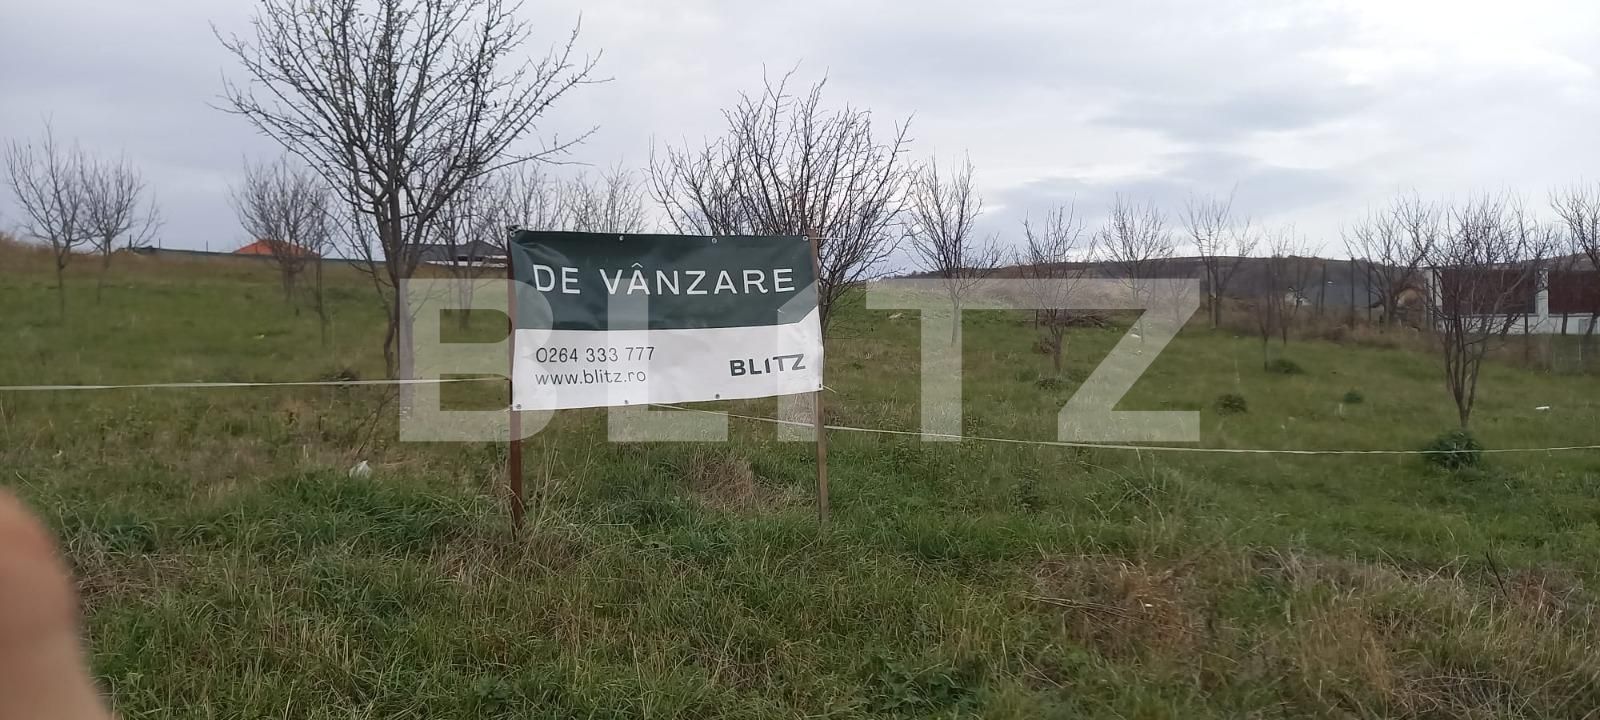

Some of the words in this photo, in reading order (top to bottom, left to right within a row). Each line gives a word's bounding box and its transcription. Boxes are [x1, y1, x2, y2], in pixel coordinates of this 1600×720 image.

[533, 264, 581, 295] DE
[599, 262, 796, 295] VÂNZARE
[535, 347, 578, 363] 0264
[586, 347, 619, 362] 333
[625, 346, 655, 362] 777
[729, 353, 806, 377] BLITZ
[535, 369, 647, 386] www.blitz.ro
